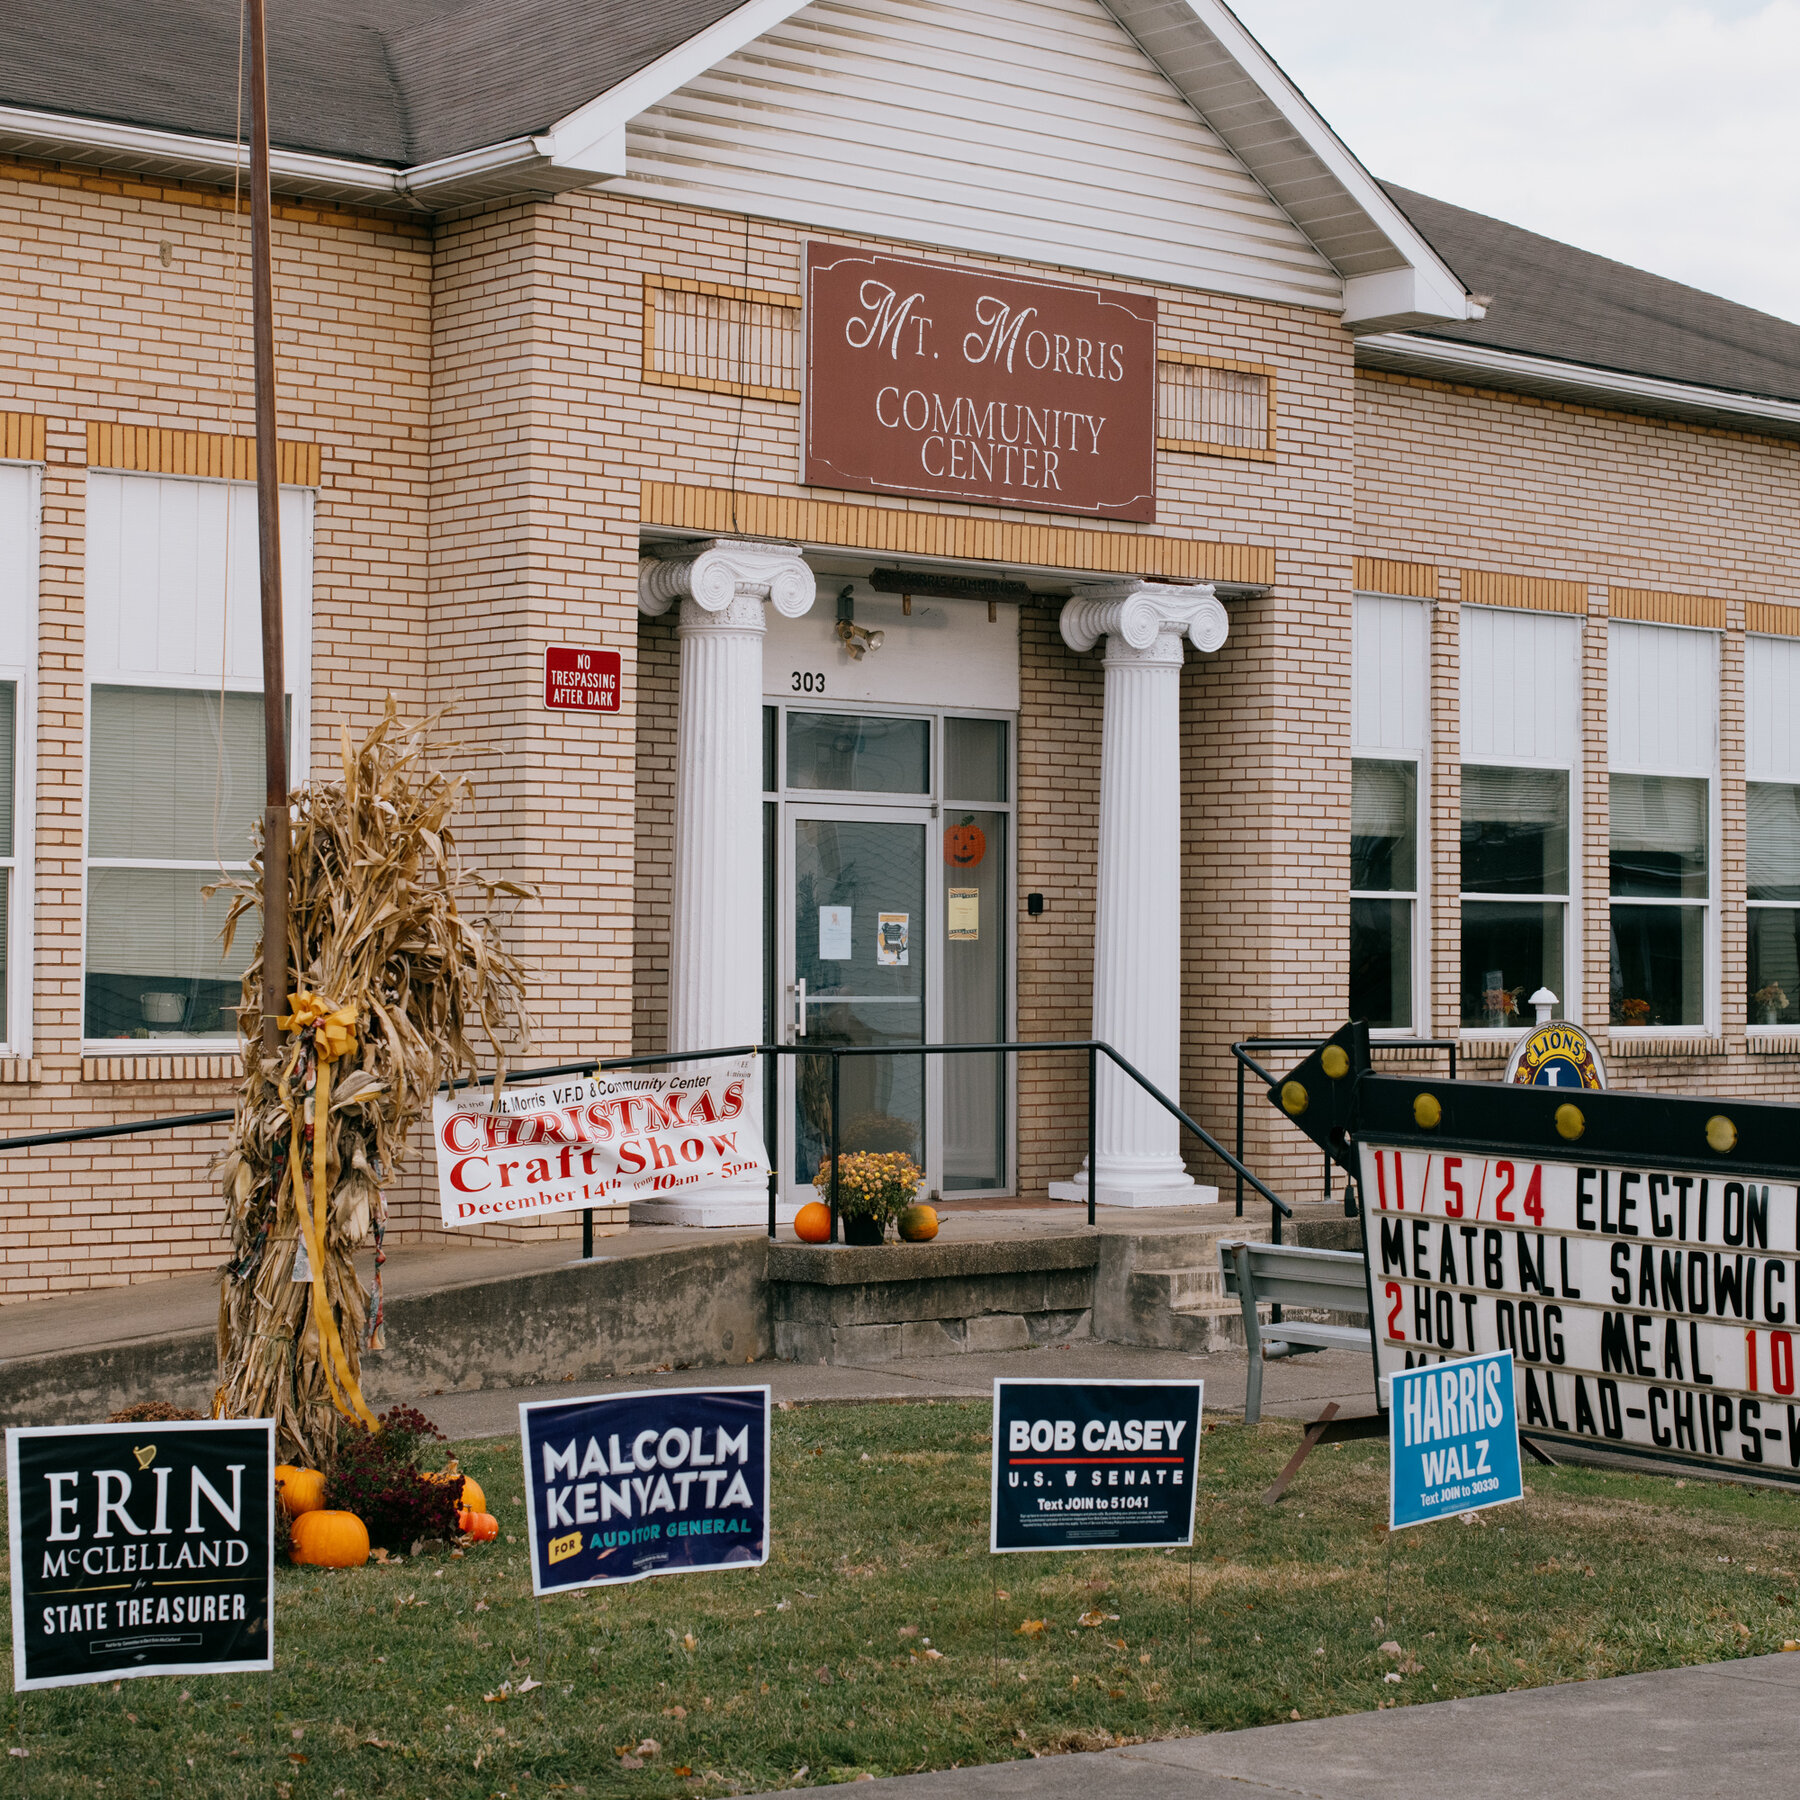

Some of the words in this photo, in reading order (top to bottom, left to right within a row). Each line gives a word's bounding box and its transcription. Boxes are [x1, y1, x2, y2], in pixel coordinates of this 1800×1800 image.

[963, 295, 1124, 382] MORRIS
[875, 386, 1107, 455] COMMUNITY
[921, 435, 1063, 491] CENTER
[551, 670, 616, 690] TRESPASSING
[577, 654, 591, 670] NO
[791, 671, 825, 693] 303
[553, 688, 584, 705] AFTER
[587, 690, 613, 707] DARK
[1531, 1031, 1583, 1058] LIONS
[441, 1079, 745, 1156] CHRISTMAS
[457, 1103, 467, 1111] At
[468, 1101, 484, 1109] the
[512, 1093, 546, 1112] Morris
[589, 1082, 597, 1098] &
[599, 1077, 666, 1096] Community
[669, 1075, 712, 1089] Center
[449, 1145, 601, 1193] Craft
[616, 1132, 738, 1175] Show
[457, 1188, 577, 1218] December
[582, 1178, 622, 1200] 14th
[632, 1174, 654, 1190] from
[652, 1172, 699, 1192] 10am
[720, 1160, 758, 1180] 5pm
[1576, 1168, 1769, 1249] ELECTION
[1381, 1217, 1580, 1299] MEATBALL
[1385, 1281, 1405, 1341] 2
[1414, 1285, 1477, 1352] HOT
[1496, 1299, 1565, 1365] DOG
[1601, 1311, 1713, 1384] MEAL
[1745, 1329, 1794, 1395] 10
[1403, 1361, 1503, 1447] HARRIS
[542, 1424, 749, 1484] MALCOLM
[1009, 1419, 1077, 1452] BOB
[1082, 1419, 1187, 1452] CASEY
[1008, 1471, 1053, 1487] U.S.
[1091, 1470, 1184, 1486] SENATE
[1421, 1439, 1492, 1488] WALZ
[43, 1464, 246, 1542] ERIN
[546, 1469, 754, 1529] KENYATTA
[1037, 1497, 1063, 1511] Text
[1064, 1496, 1094, 1510] JOIN
[1096, 1498, 1109, 1509] to
[1110, 1496, 1149, 1509] 51041
[1420, 1491, 1439, 1507] Text
[1440, 1485, 1461, 1503] JOIN
[1461, 1483, 1471, 1497] to
[1472, 1477, 1499, 1495] 30330
[554, 1540, 576, 1556] FOR
[589, 1524, 661, 1549] AUDITOR
[666, 1518, 752, 1538] GENERAL
[132, 1576, 147, 1592] for
[42, 1602, 108, 1635] STATE
[116, 1593, 246, 1628] TREASURER
